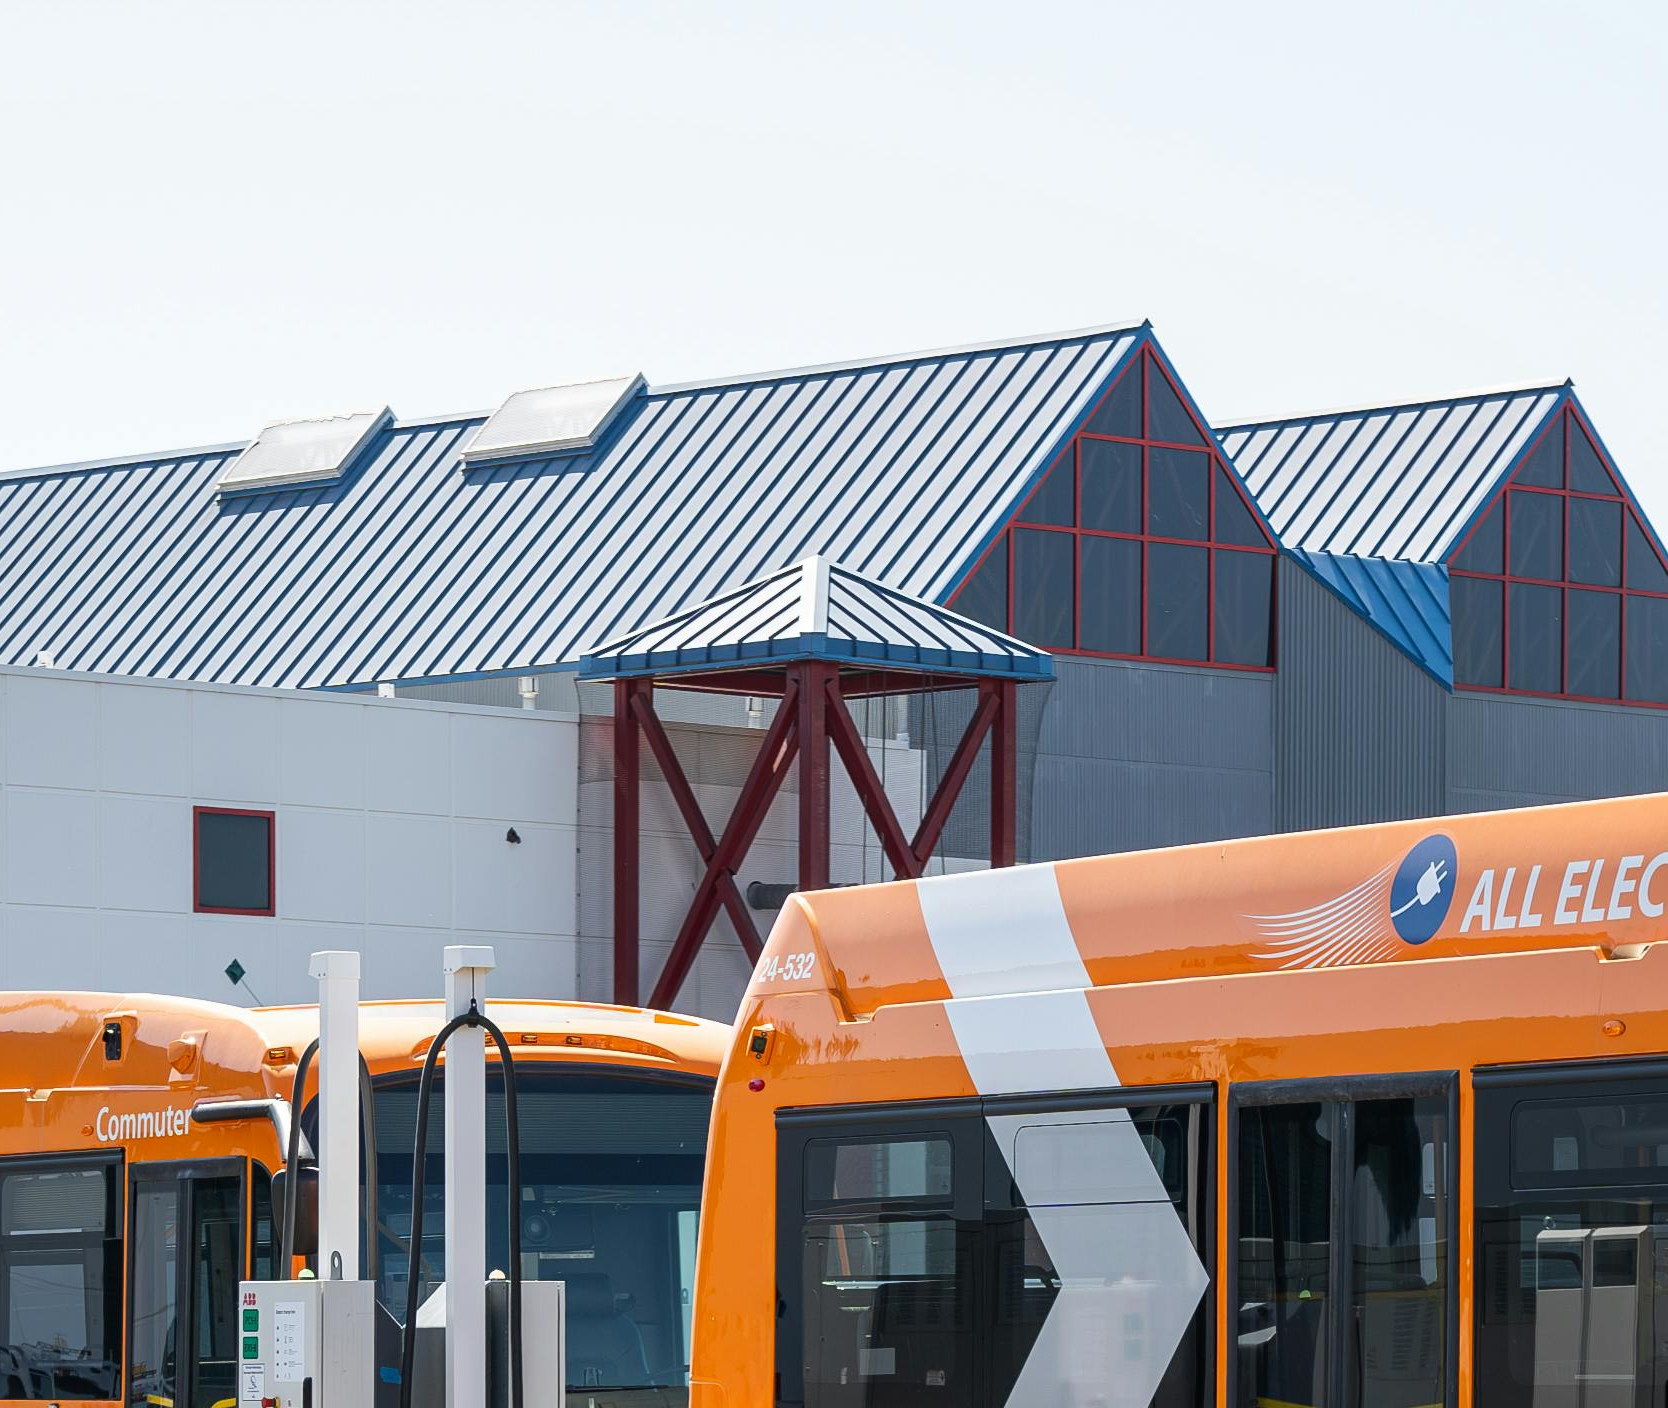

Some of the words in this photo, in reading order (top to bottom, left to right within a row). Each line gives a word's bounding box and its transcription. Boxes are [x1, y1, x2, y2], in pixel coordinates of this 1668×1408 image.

[1459, 864, 1542, 933] ALL
[757, 952, 815, 983] 24-532
[96, 1104, 191, 1142] Commuter
[243, 1292, 257, 1306] ABB
